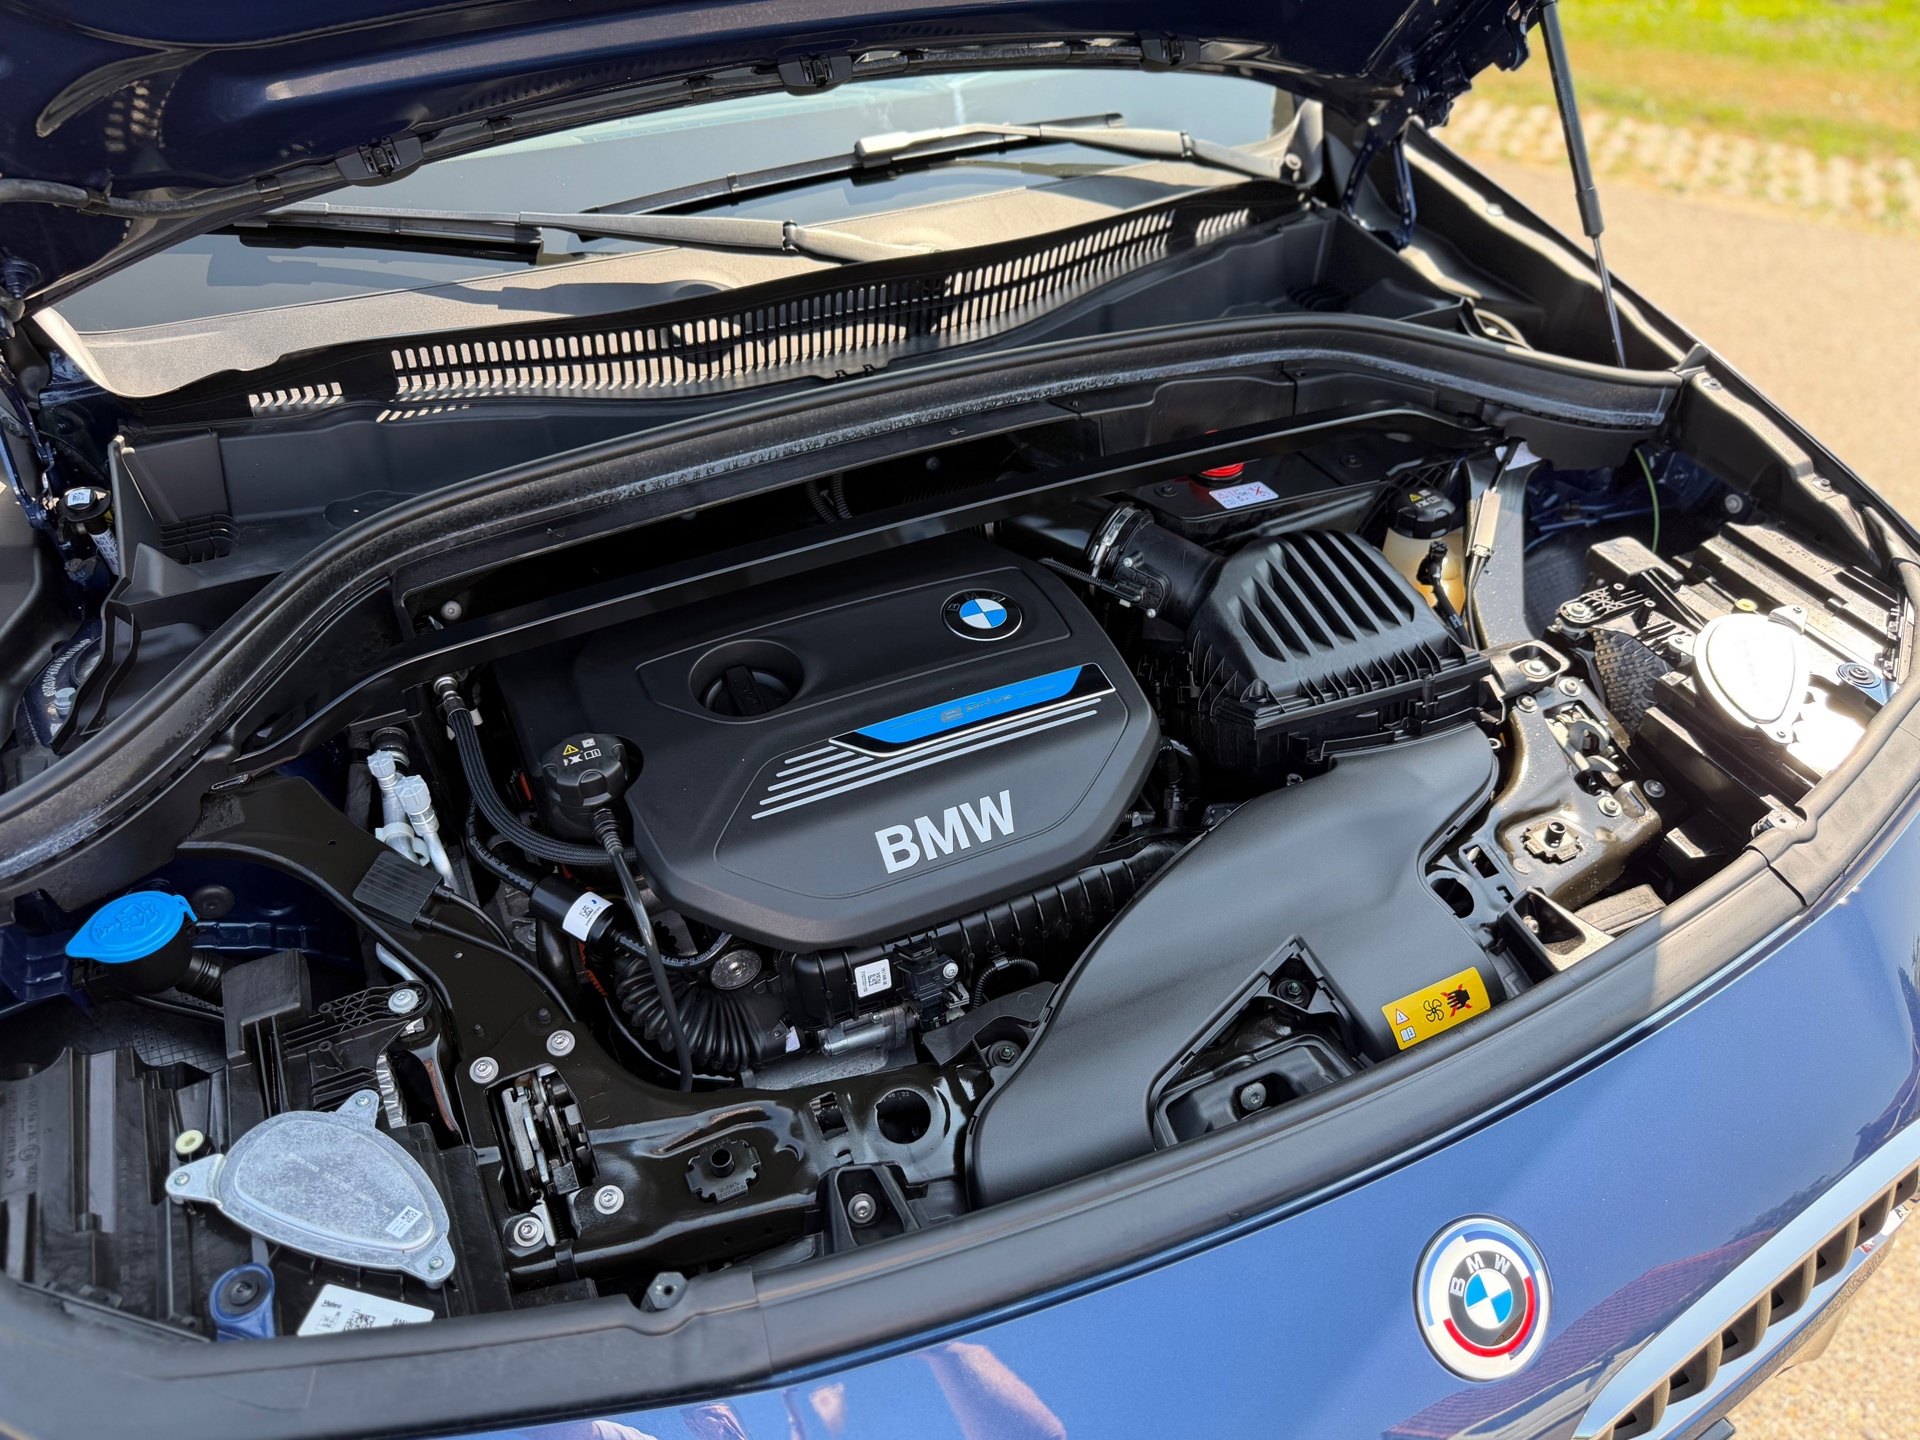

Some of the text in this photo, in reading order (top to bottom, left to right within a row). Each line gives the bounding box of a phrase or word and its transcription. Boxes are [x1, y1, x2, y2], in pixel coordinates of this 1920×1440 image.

[946, 591, 1006, 612] BMW
[874, 789, 1015, 874] BMW
[1449, 1252, 1511, 1297] BMW
